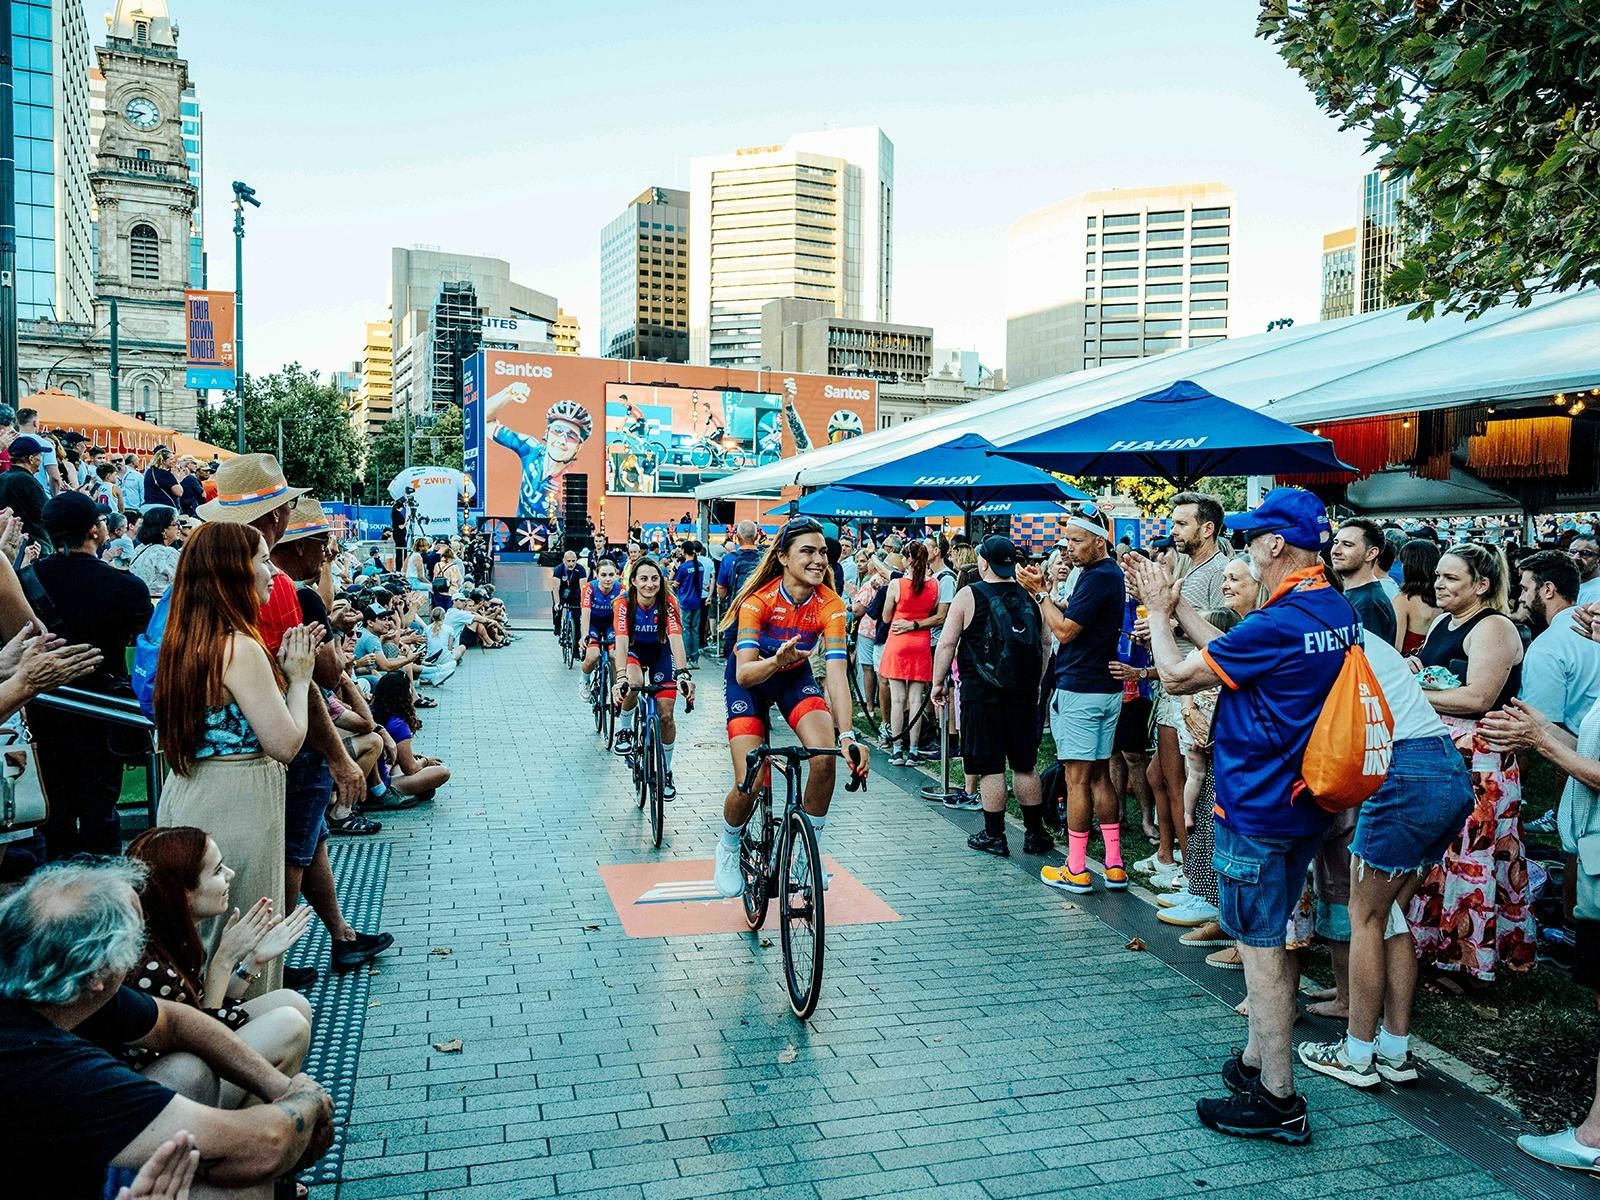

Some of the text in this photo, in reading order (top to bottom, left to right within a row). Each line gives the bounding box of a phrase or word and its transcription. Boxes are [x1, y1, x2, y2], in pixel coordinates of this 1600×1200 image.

[189, 300, 209, 320] TOUR
[189, 320, 213, 339] DOWN
[190, 340, 215, 359] UNDER
[494, 360, 553, 379] Santos
[824, 384, 870, 400] Santos
[1106, 436, 1208, 451] HAHN
[913, 475, 981, 486] HAHN
[835, 509, 873, 517] HAHN
[974, 503, 1012, 513] AHN
[1303, 626, 1350, 654] EVENT
